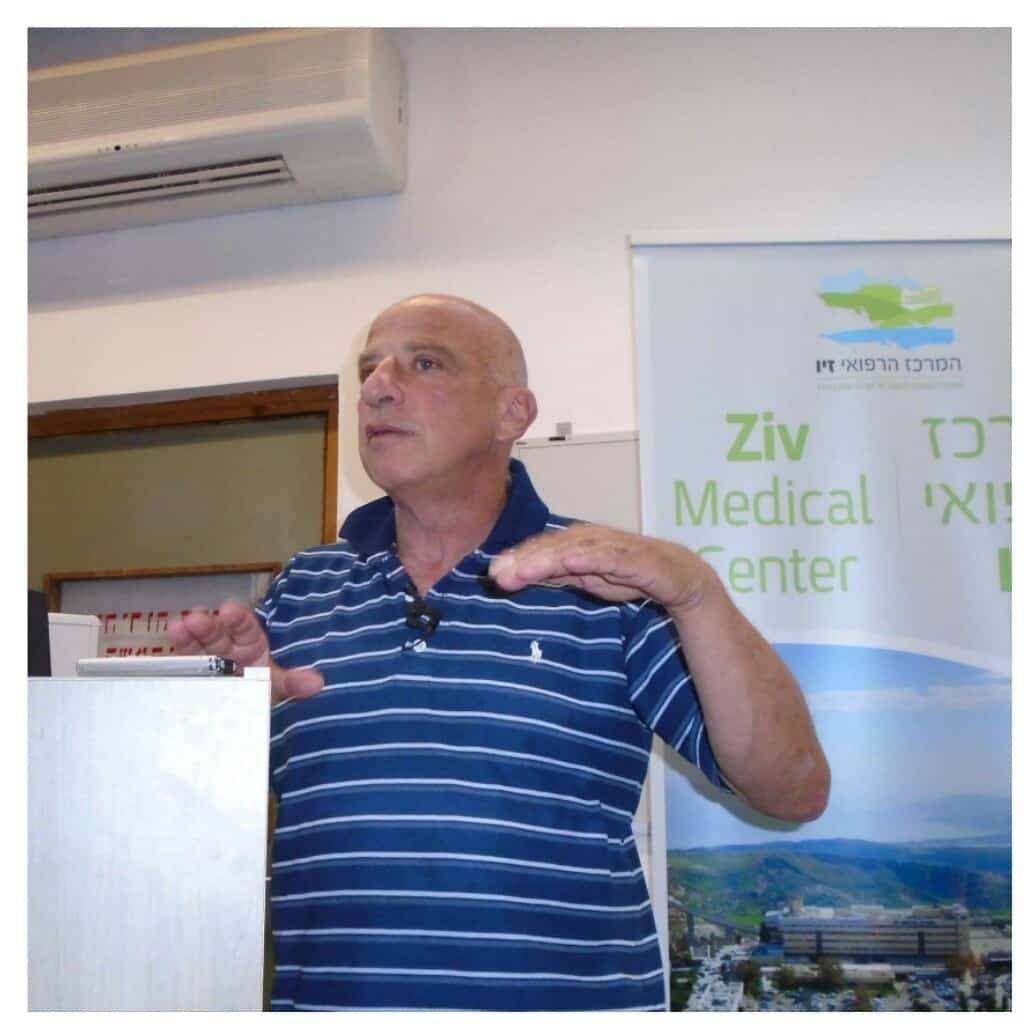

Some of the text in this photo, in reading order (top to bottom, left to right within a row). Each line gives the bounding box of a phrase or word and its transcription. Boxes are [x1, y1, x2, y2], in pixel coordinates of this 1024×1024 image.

[816, 357, 962, 373] המרכז הרפואי זיו
[725, 411, 811, 462] Ziv
[673, 474, 874, 527] Medical
[924, 481, 1012, 527] ואי
[695, 546, 859, 594] enter
